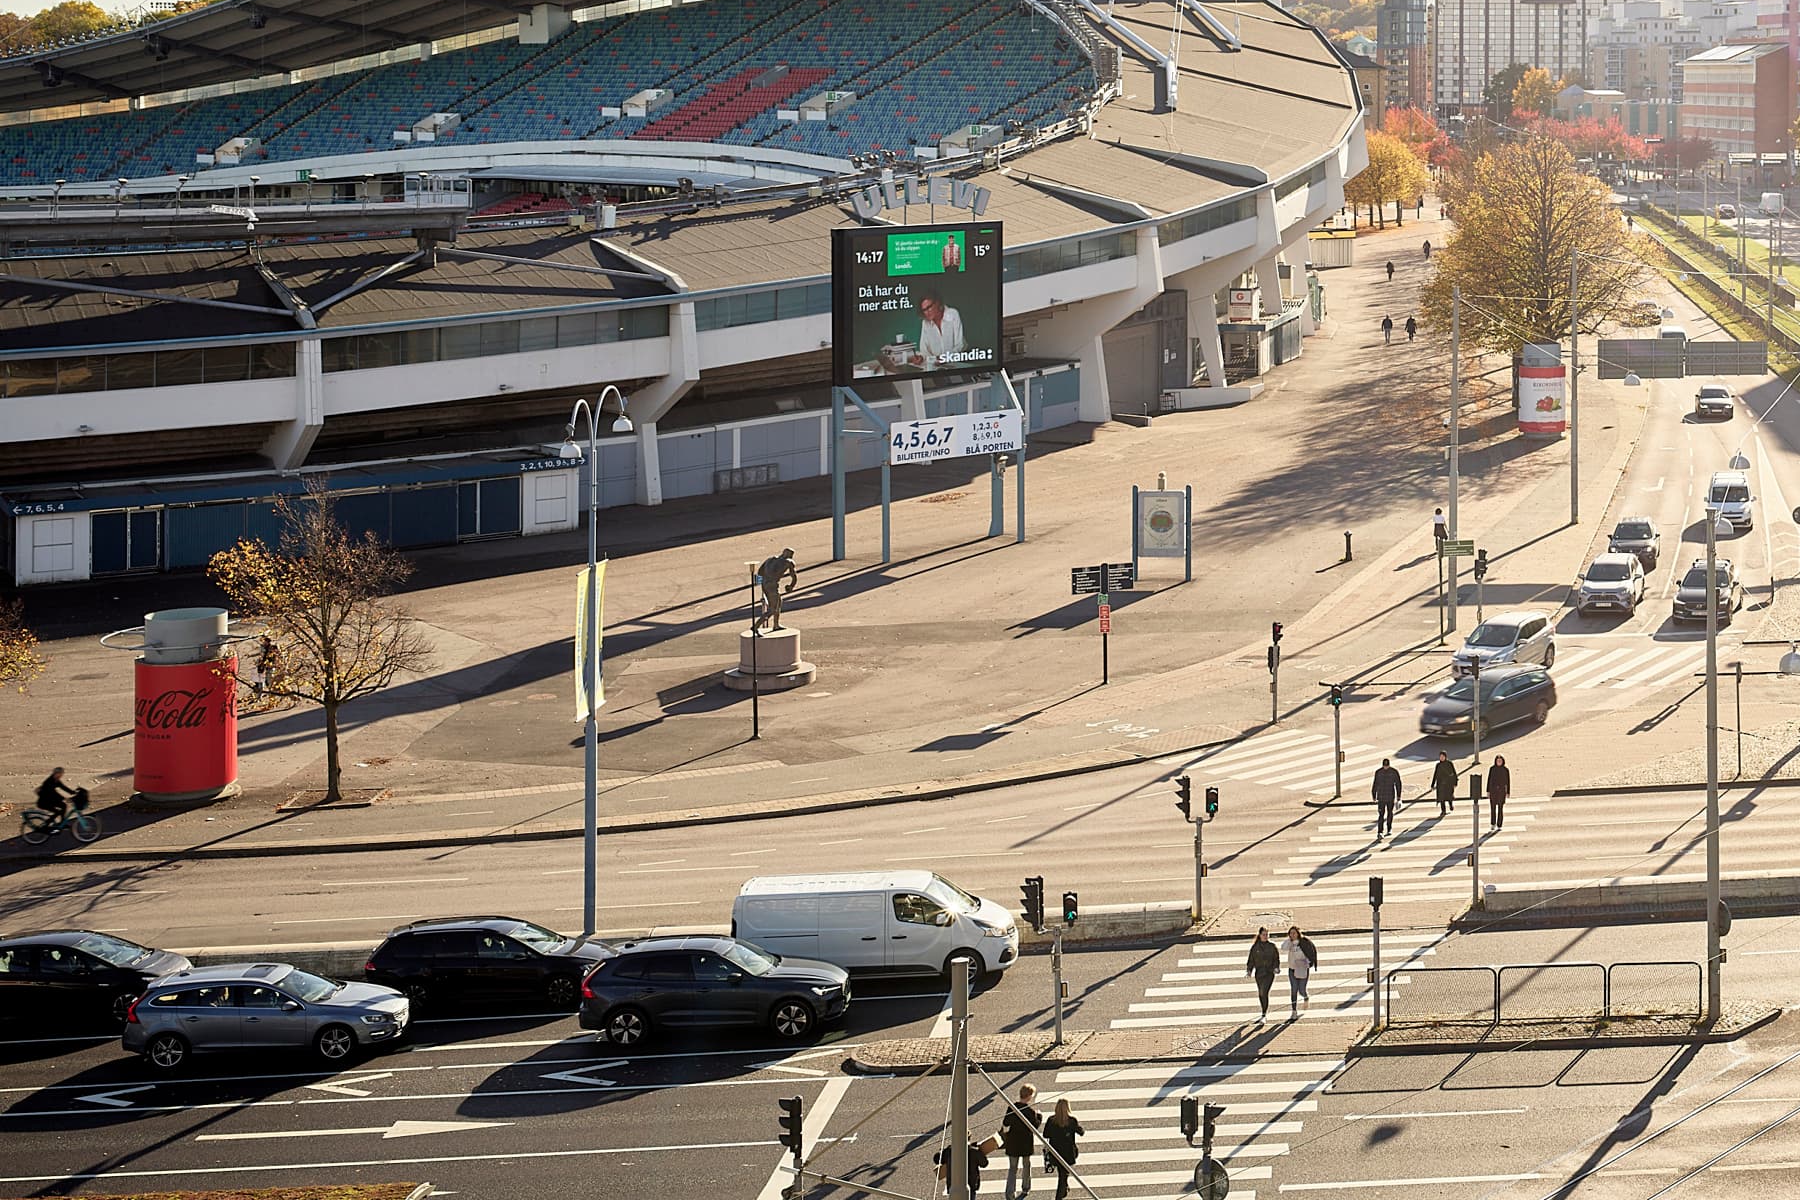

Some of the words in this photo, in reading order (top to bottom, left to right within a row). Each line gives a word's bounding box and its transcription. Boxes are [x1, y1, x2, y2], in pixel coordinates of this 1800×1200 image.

[848, 175, 991, 218] ULLEVI
[974, 244, 990, 256] 15°
[856, 251, 884, 263] 14:17
[858, 285, 873, 298] Då
[875, 285, 893, 296] har
[894, 283, 908, 295] du
[1236, 292, 1244, 301] G
[859, 302, 879, 312] mer
[881, 300, 898, 310] att
[899, 297, 913, 309] få.
[892, 427, 954, 450] 4,5,6,7
[965, 444, 981, 455] BLÅ
[983, 441, 1014, 453] PORTEN
[544, 460, 555, 468] 10,
[25, 505, 33, 513] 7,
[46, 504, 56, 512] 5,
